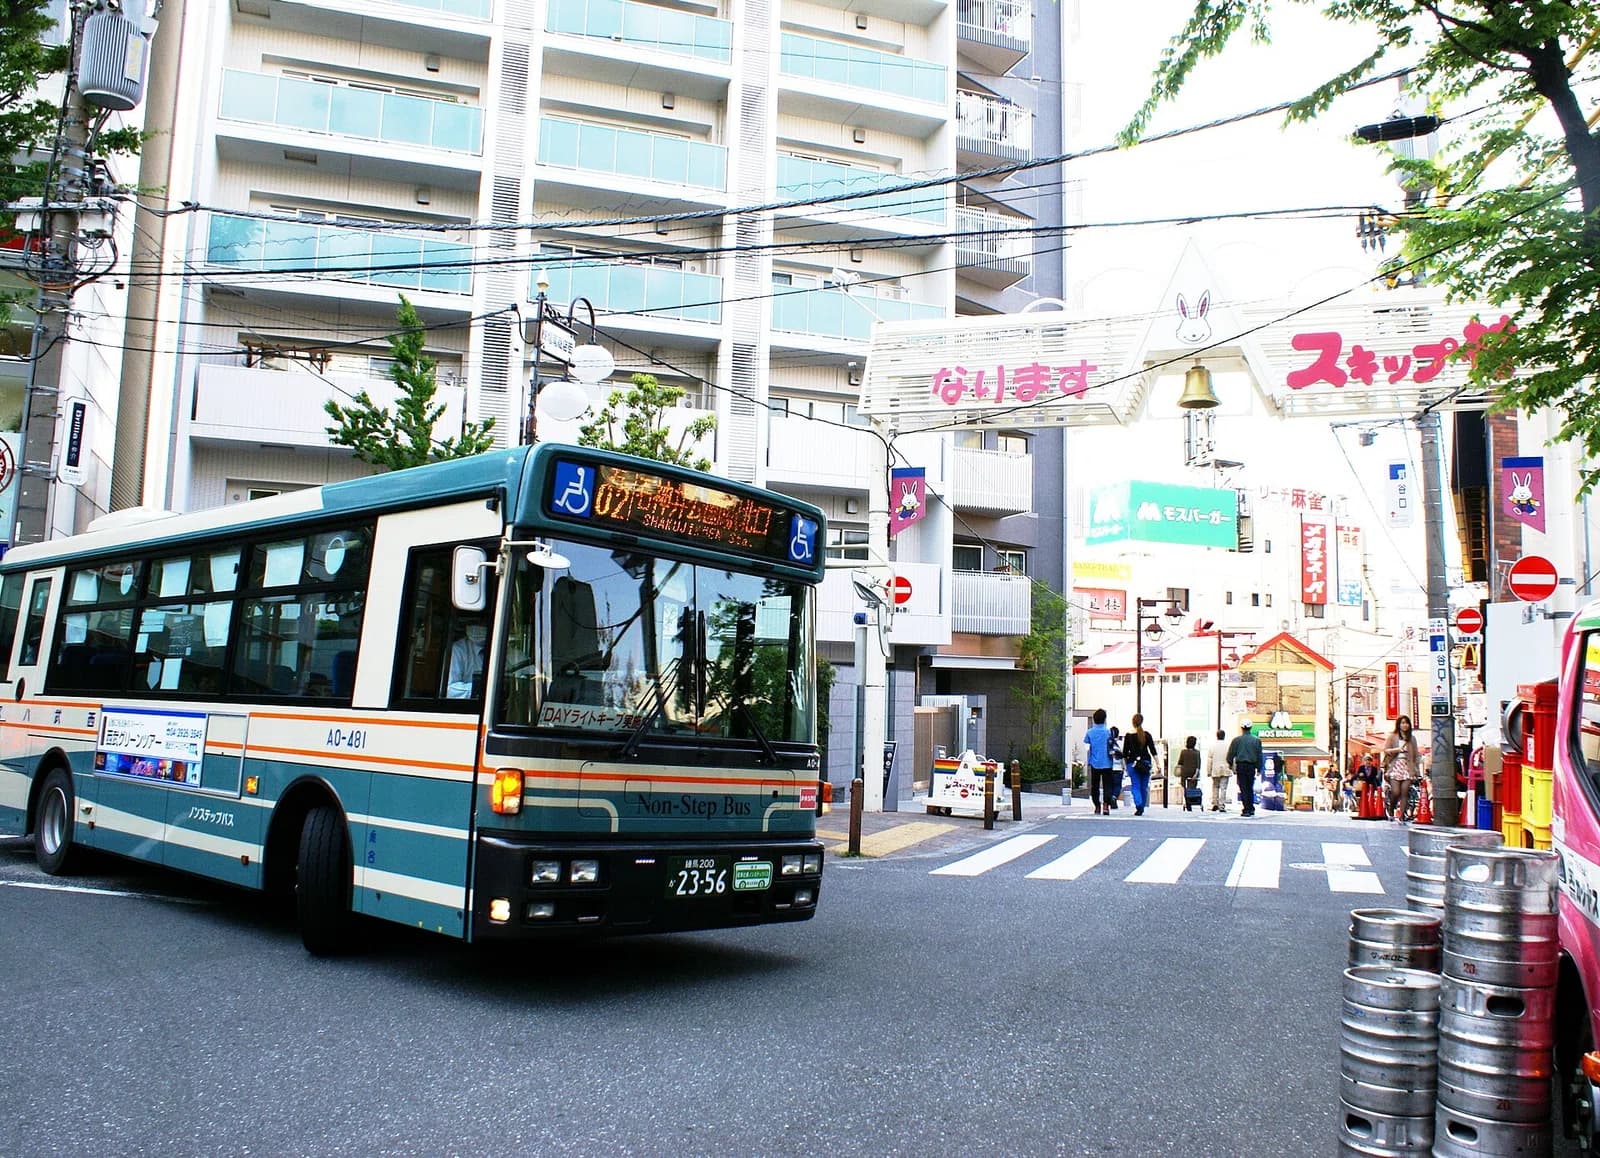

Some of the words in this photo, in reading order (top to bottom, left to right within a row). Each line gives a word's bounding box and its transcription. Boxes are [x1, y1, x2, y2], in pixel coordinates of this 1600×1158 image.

[1286, 314, 1519, 390] スキップ
[931, 359, 1098, 406] なります
[1162, 506, 1231, 526] モスバーガー
[543, 707, 646, 728] DAYライトキープ実施
[1258, 730, 1275, 738] MOS
[1276, 730, 1303, 738] BURGER
[188, 806, 234, 827] ノンステップバス
[638, 794, 717, 820] Non-Step
[723, 796, 751, 815] Bus
[699, 859, 715, 869] 200
